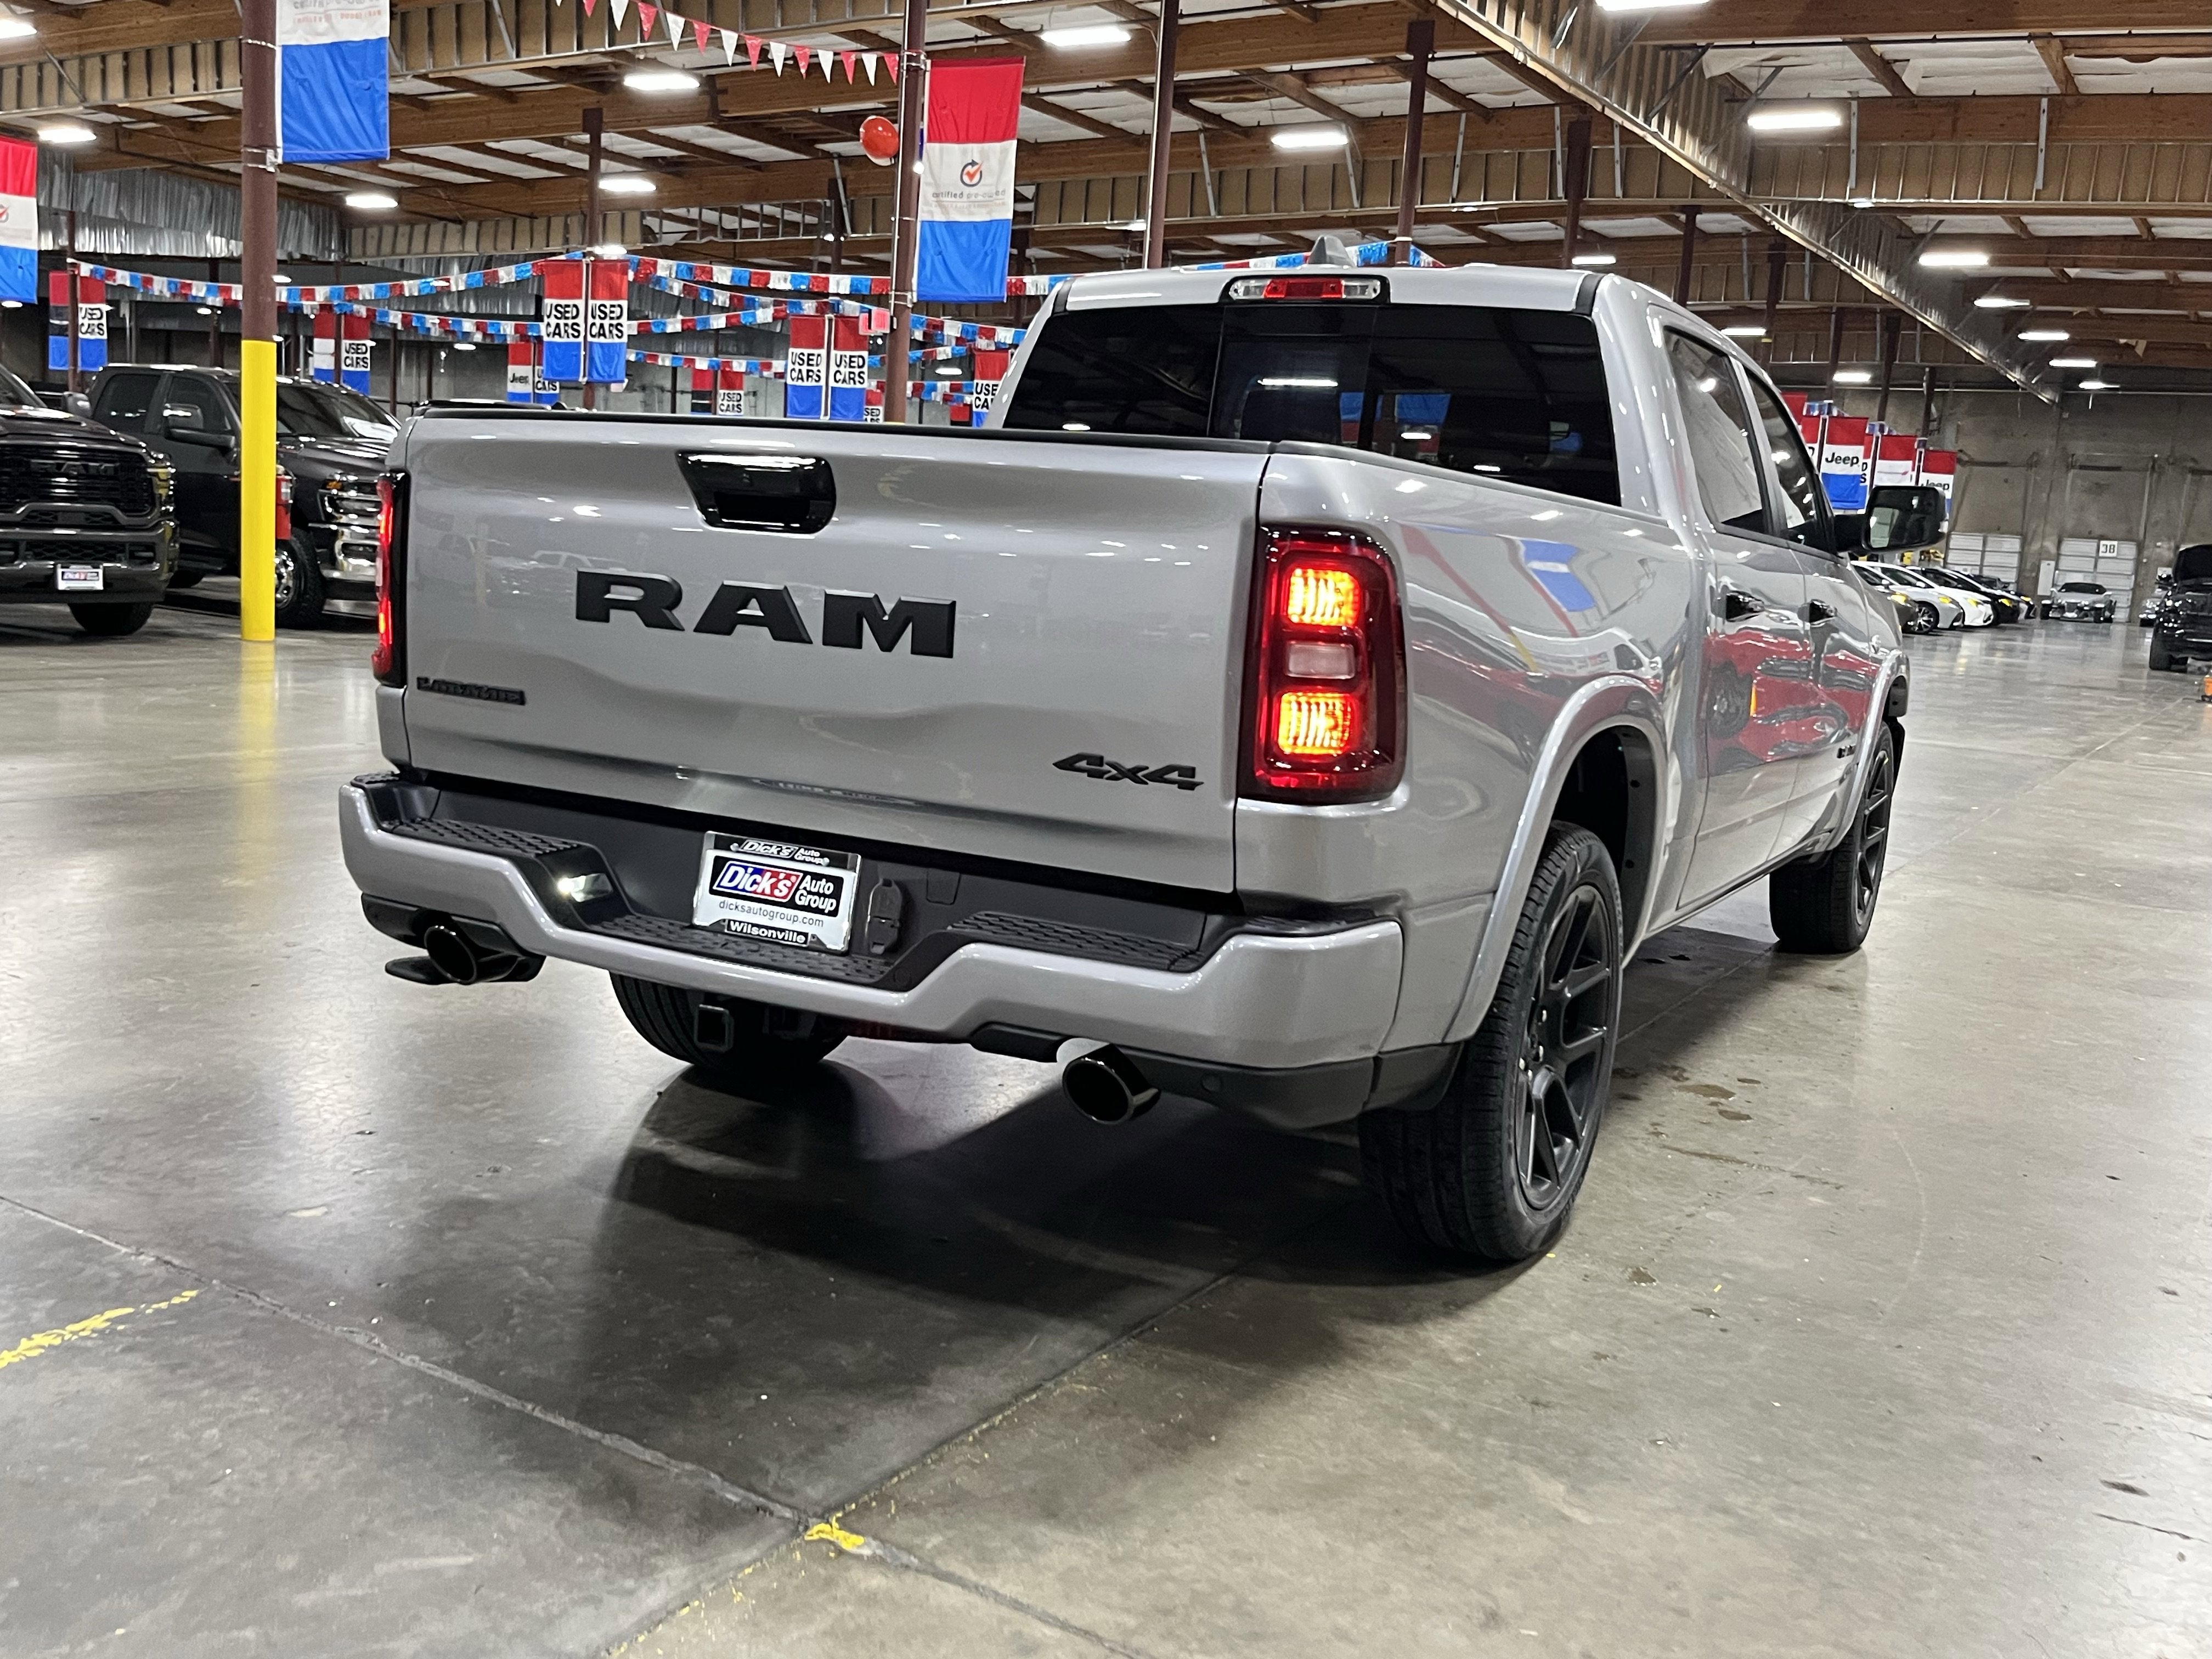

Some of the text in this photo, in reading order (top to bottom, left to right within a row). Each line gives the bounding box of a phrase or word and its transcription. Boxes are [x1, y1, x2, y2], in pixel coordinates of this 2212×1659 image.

[546, 303, 579, 320] USED
[591, 303, 623, 320] USED
[545, 321, 581, 338] CARS
[589, 321, 624, 339] CARS
[791, 352, 822, 367] USED
[835, 353, 866, 369] USED
[790, 368, 821, 383] CARS
[834, 370, 866, 385] CARS
[975, 382, 999, 396] USE
[864, 407, 881, 416] SED
[1825, 452, 1859, 467] Jeep
[2101, 544, 2115, 554] 38
[575, 567, 956, 658] RAM
[797, 848, 821, 857] Auto
[720, 864, 792, 898] Dick's
[799, 875, 834, 895] Auto
[795, 890, 837, 913] Group
[719, 899, 824, 927] dicksautogroup.com
[730, 920, 806, 944] Wilsonville
